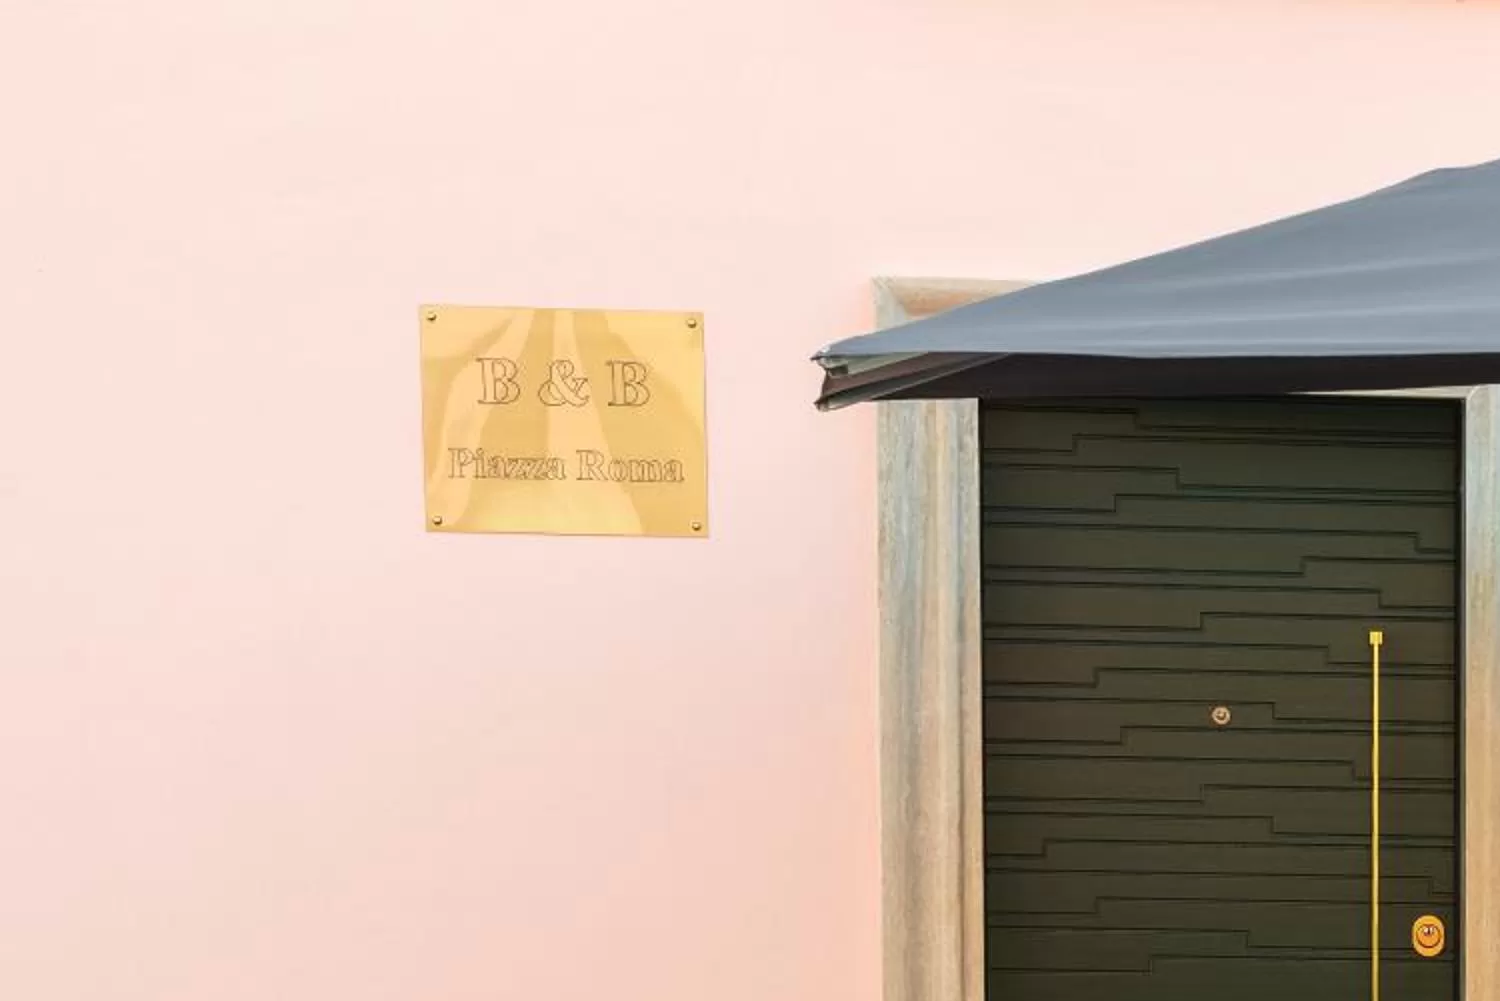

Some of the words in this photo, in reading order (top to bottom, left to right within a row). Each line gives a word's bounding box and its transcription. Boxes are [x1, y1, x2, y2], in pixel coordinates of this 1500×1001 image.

[476, 357, 521, 405] B
[538, 359, 590, 407] &
[606, 359, 651, 407] B
[447, 447, 567, 481] Piazza
[576, 449, 685, 483] Roma
